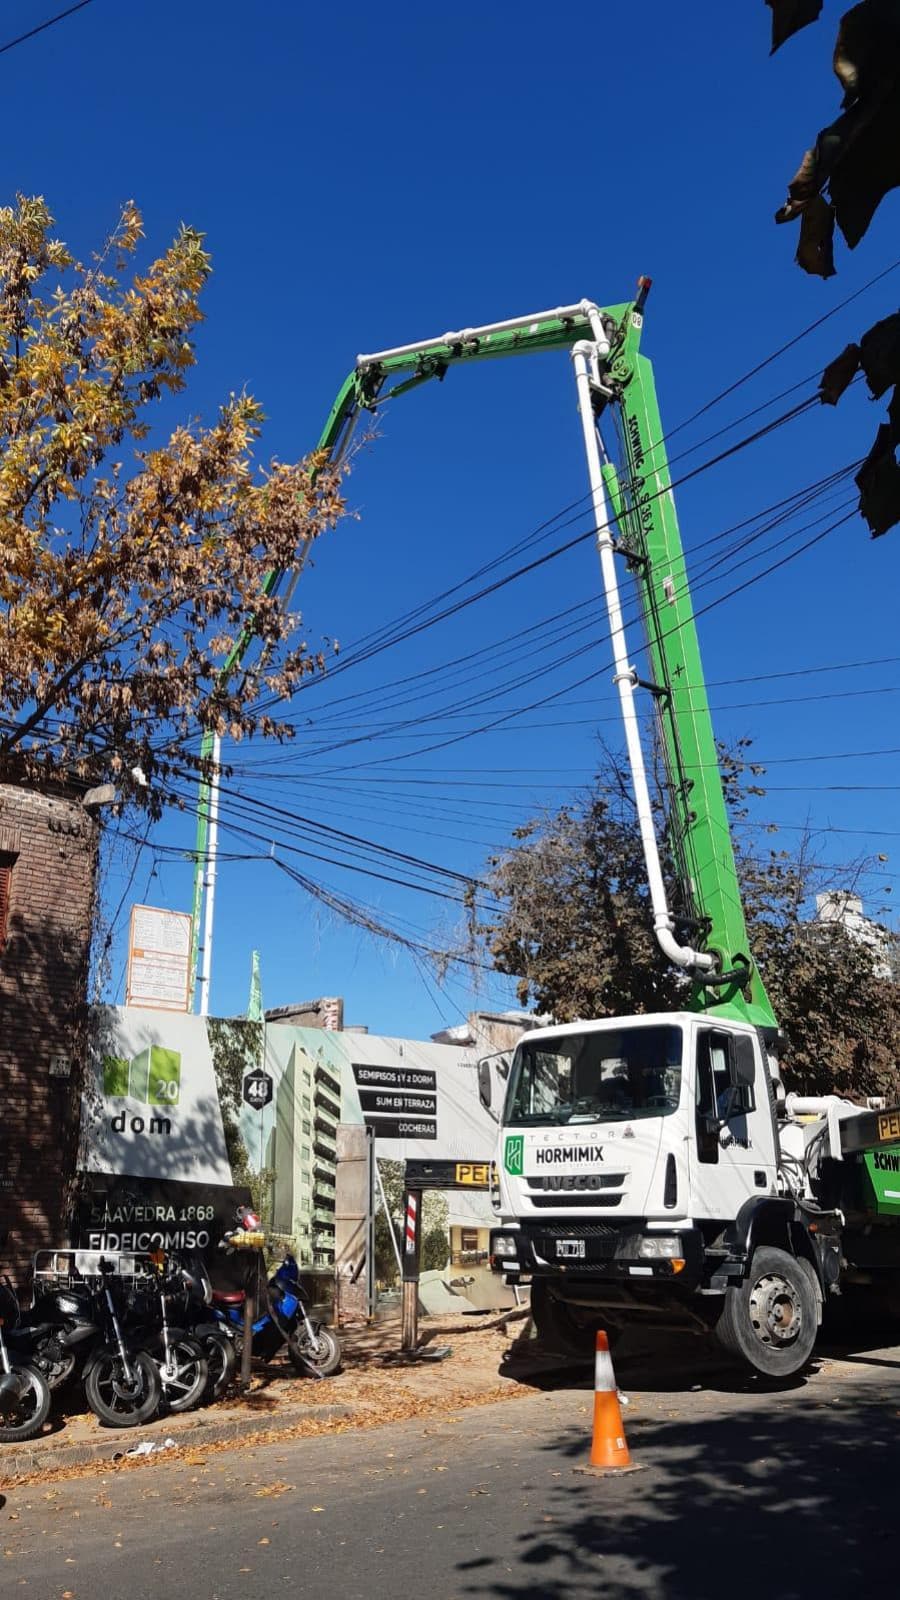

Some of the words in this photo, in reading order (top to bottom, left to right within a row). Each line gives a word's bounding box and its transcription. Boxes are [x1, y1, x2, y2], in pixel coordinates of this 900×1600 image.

[629, 414, 644, 469] SCHWING
[358, 1070, 397, 1082] SEMIPISOS
[156, 1079, 178, 1100] 20
[248, 1080, 268, 1098] 48
[375, 1097, 393, 1106] SUM
[403, 1098, 435, 1109] TERRAZA
[110, 1110, 172, 1135] dom
[398, 1123, 436, 1134] COCHERAS
[880, 1112, 900, 1137] PE
[528, 1129, 616, 1142] TECTOR
[536, 1145, 605, 1164] HORMIMIX
[543, 1175, 601, 1191] IVECO
[91, 1205, 176, 1223] SAAVEDRA
[179, 1205, 214, 1221] 1868
[89, 1230, 210, 1251] FIDEICOMISO
